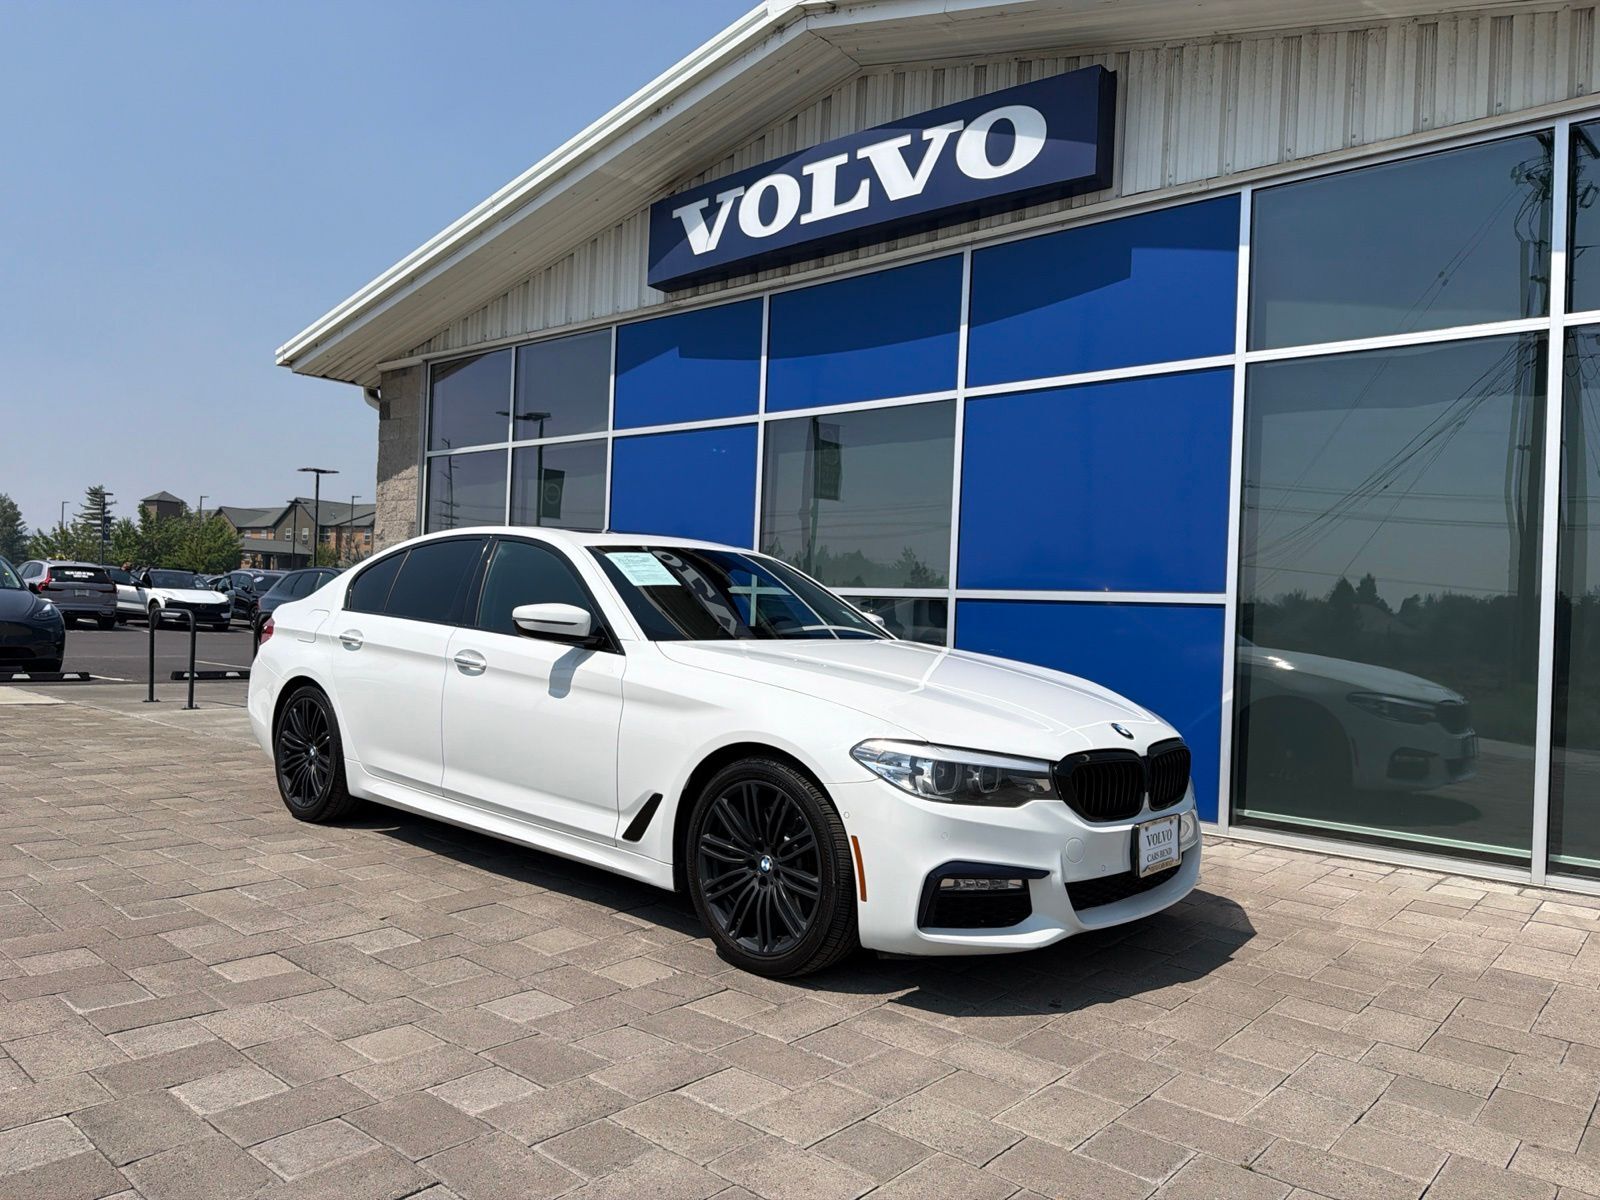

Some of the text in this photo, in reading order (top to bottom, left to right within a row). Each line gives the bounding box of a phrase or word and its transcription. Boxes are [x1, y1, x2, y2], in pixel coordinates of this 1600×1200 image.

[672, 104, 1048, 256] VOLVO
[1147, 828, 1173, 847] VOLVO
[1147, 852, 1160, 863] CARS
